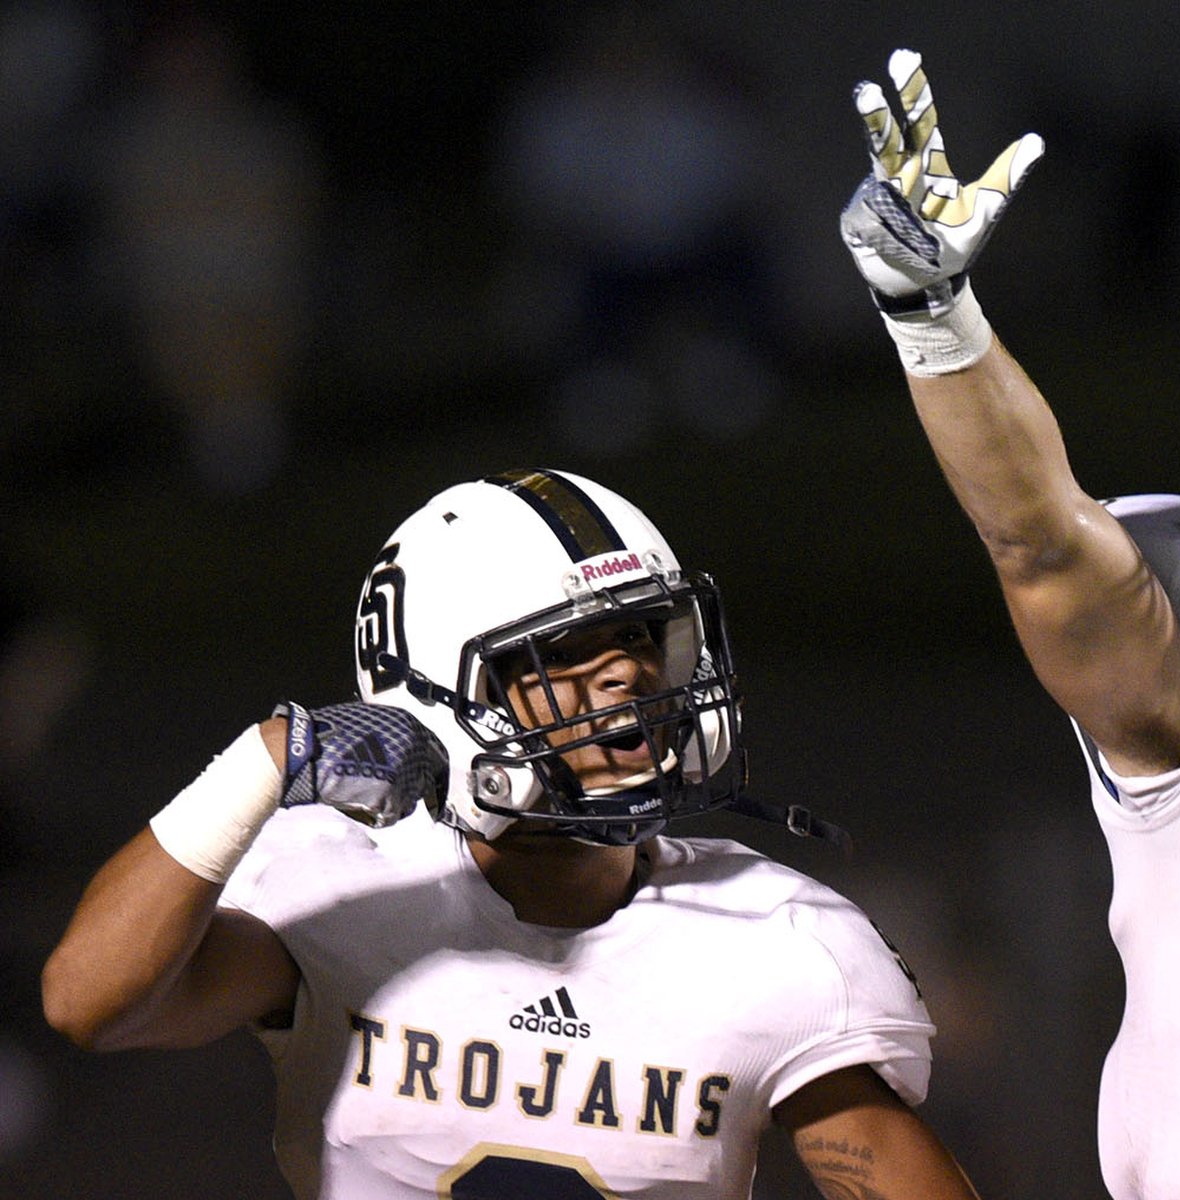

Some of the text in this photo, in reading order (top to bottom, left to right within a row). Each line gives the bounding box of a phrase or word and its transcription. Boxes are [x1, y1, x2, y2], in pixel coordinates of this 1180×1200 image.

[580, 553, 642, 582] Riddell
[508, 1013, 591, 1039] adidas
[348, 1009, 732, 1140] TROJANS
